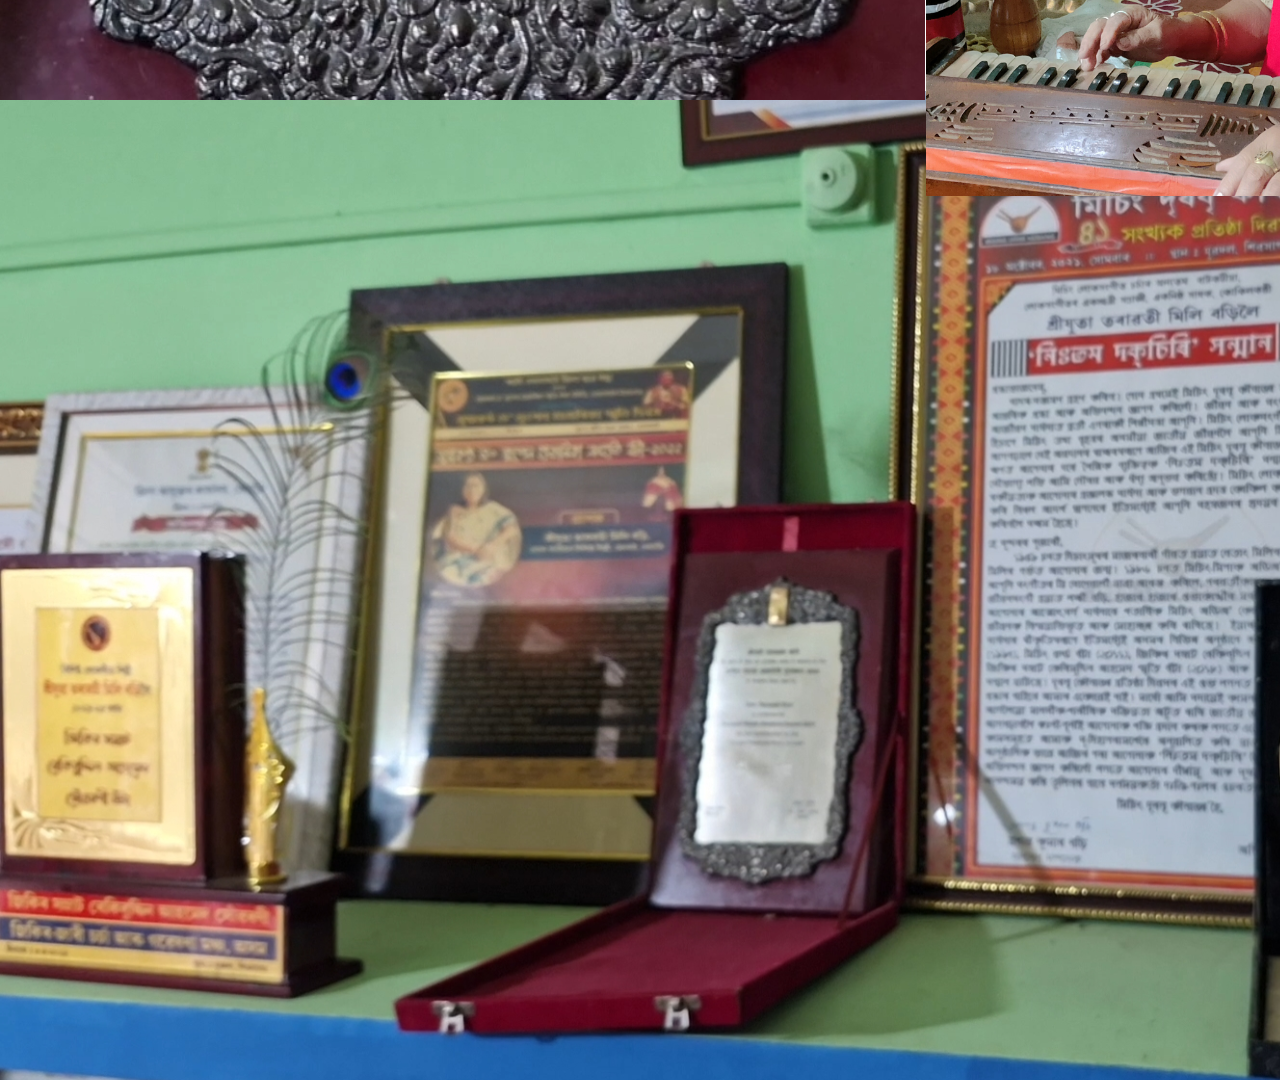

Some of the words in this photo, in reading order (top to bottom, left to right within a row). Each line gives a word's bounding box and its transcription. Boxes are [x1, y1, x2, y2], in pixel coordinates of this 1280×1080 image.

[1121, 221, 1184, 244] সংখ্যক
[1191, 217, 1242, 239] প্ৰতিষ্ঠা
[1168, 306, 1203, 324] মিলি
[1209, 332, 1274, 359] সন্মান
